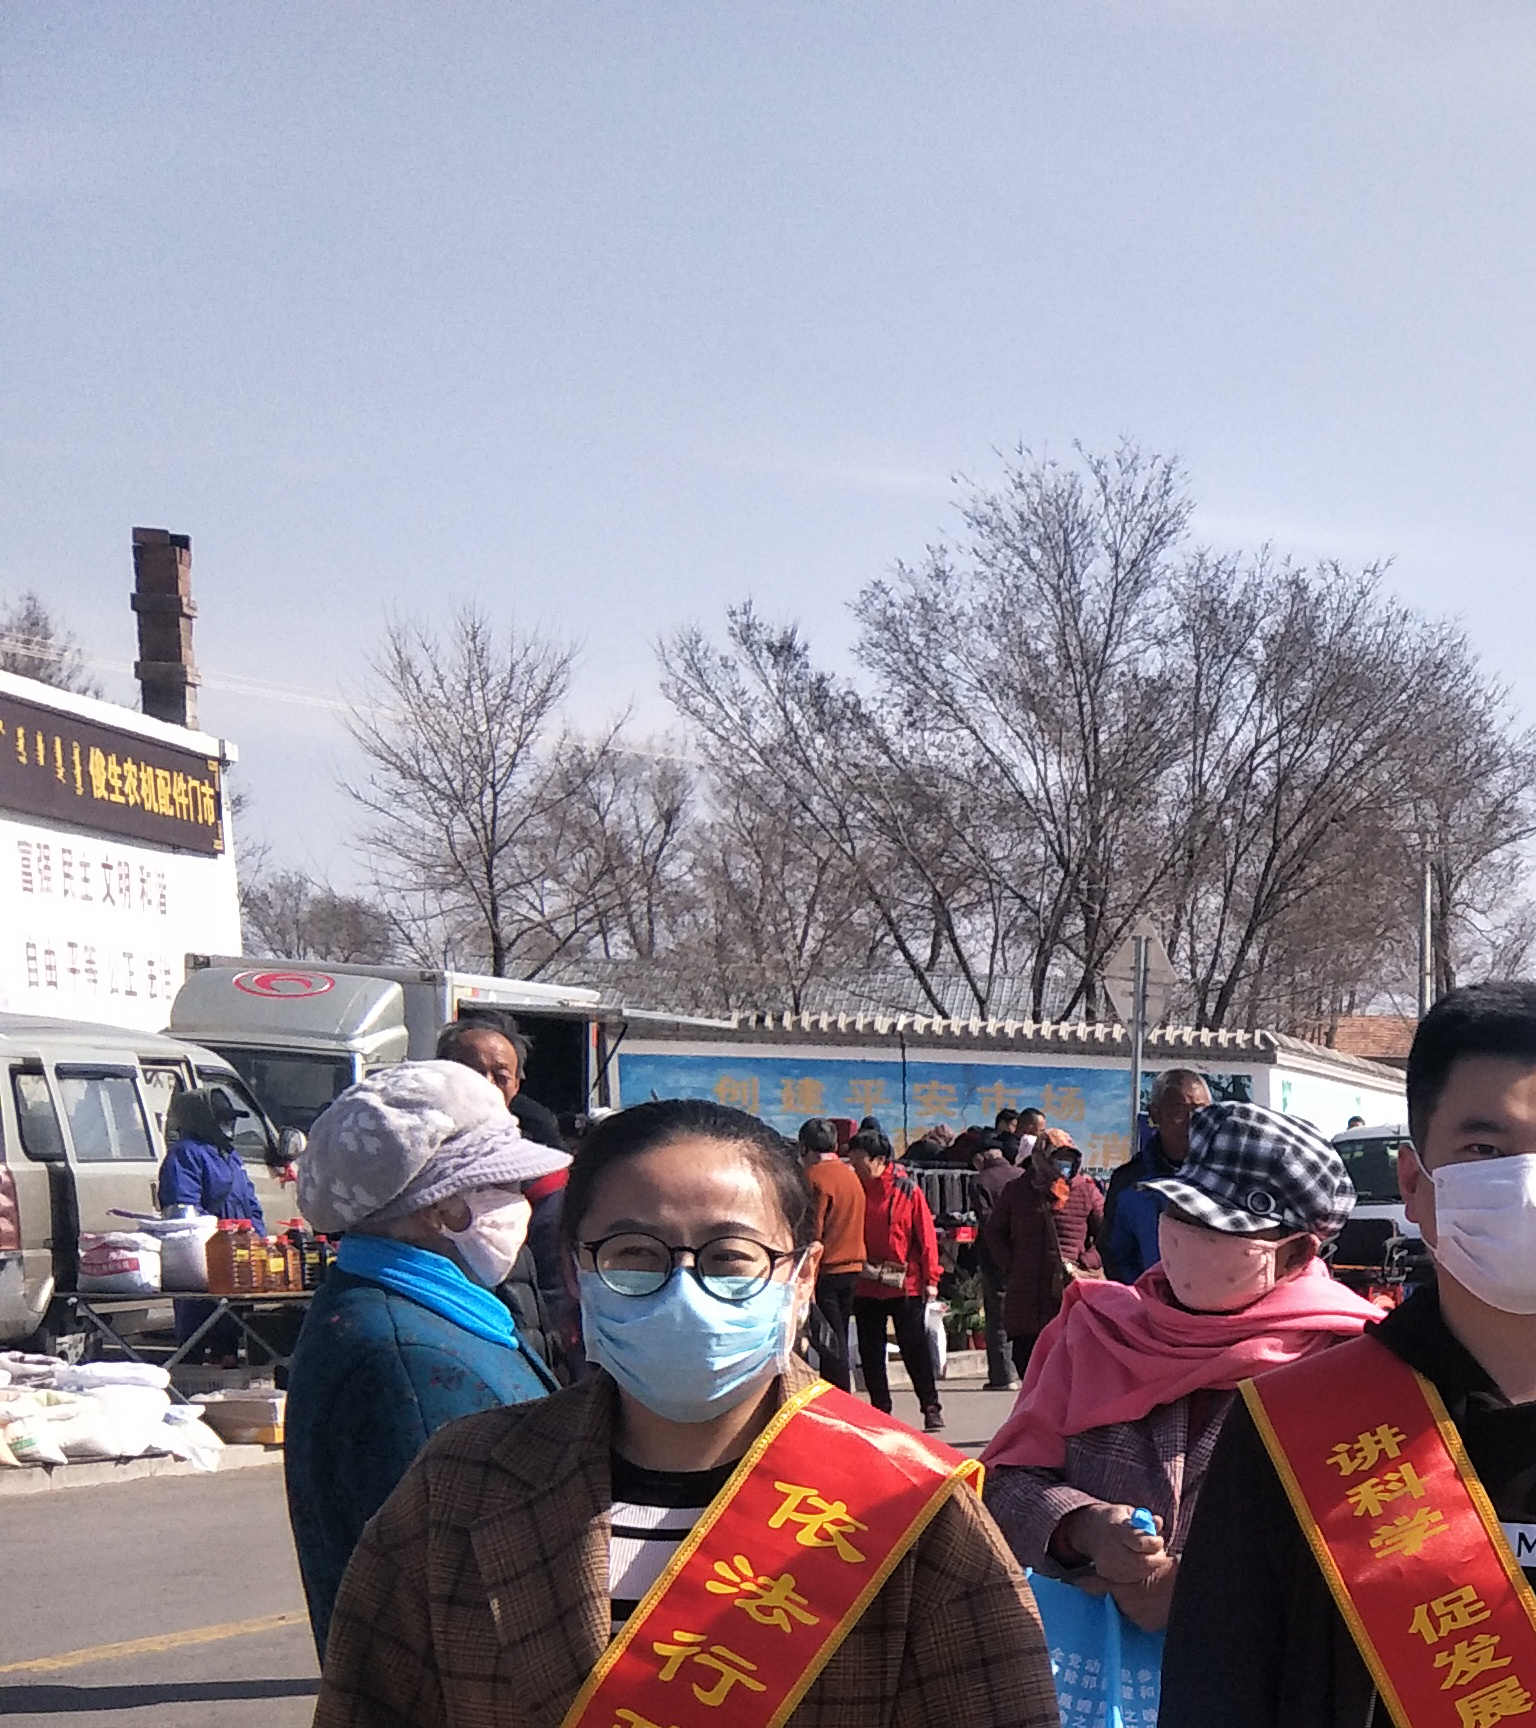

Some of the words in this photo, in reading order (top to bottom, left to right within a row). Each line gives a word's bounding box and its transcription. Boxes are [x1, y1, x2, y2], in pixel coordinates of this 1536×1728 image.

[62, 848, 93, 901] 民主
[101, 855, 131, 910] 文明
[714, 1076, 1086, 1122] 创建平安市场
[1325, 1423, 1449, 1561] 讲科学
